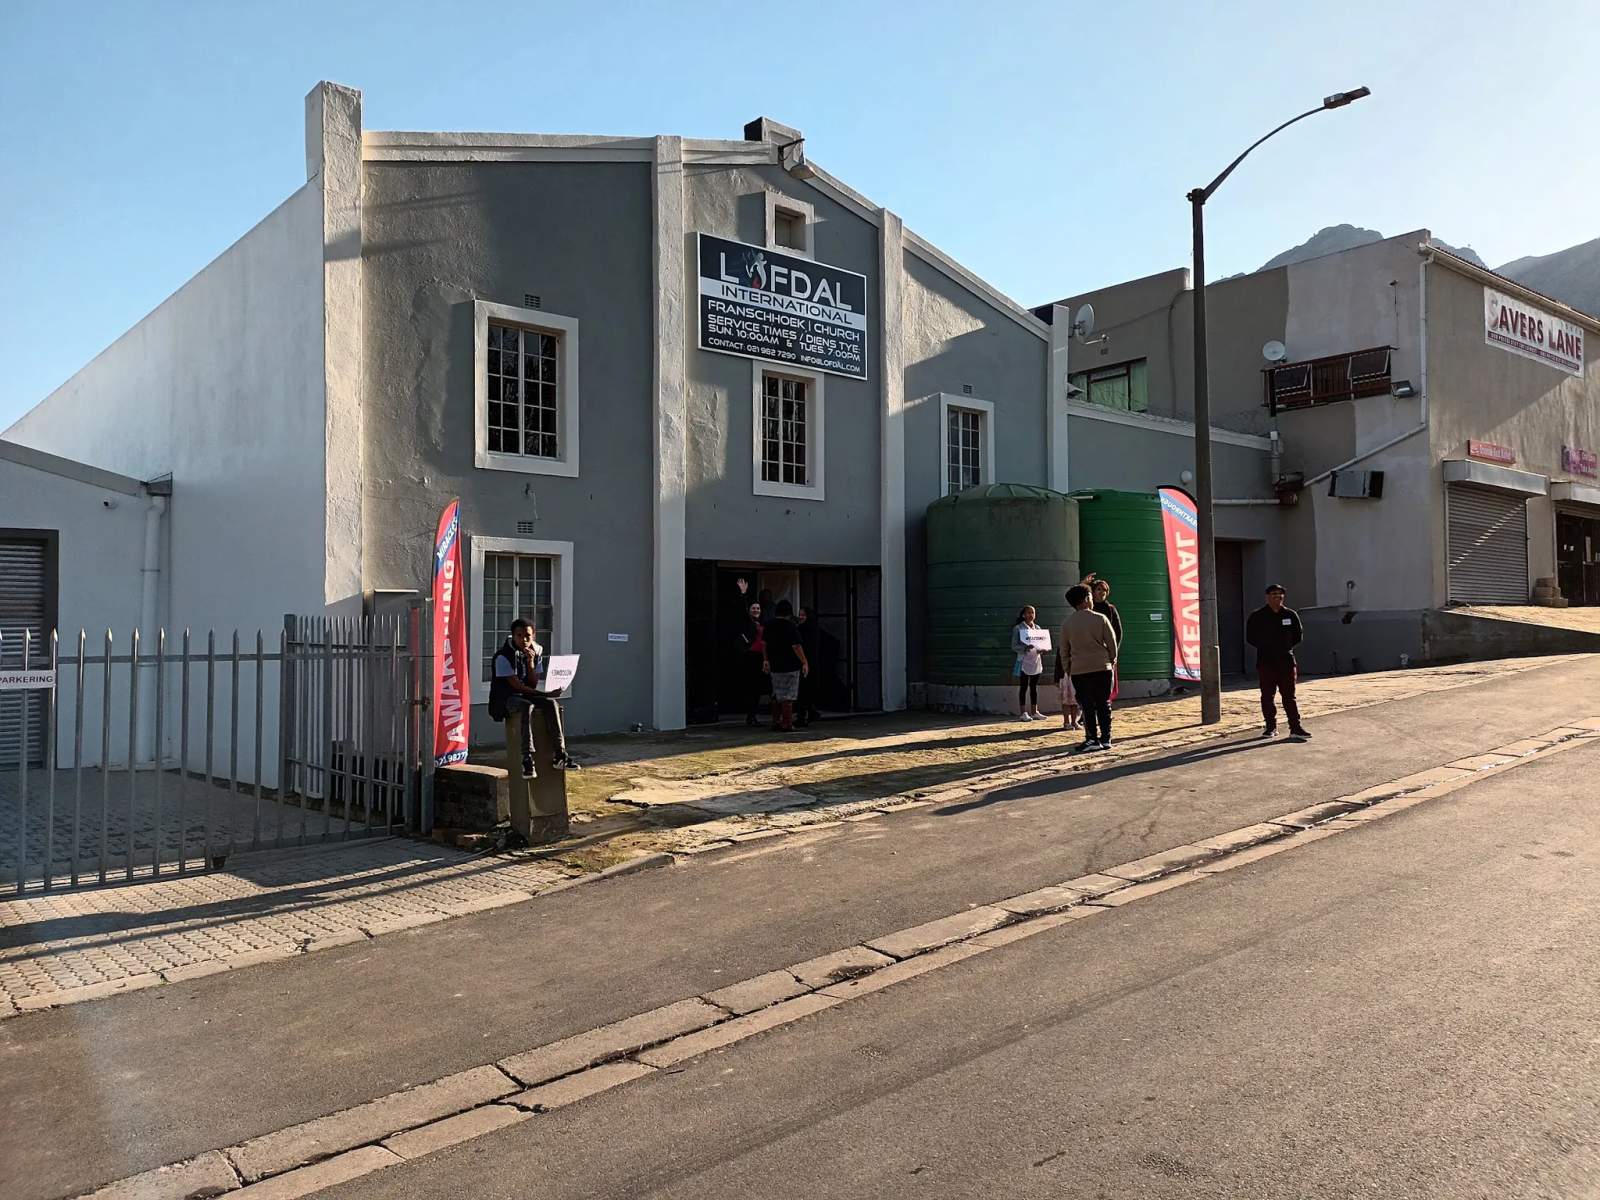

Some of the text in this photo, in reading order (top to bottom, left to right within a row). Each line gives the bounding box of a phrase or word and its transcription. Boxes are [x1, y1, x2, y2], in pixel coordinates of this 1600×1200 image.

[708, 300, 806, 330] FRANSCHHOEK
[814, 323, 860, 342] CHURCH
[721, 284, 853, 325] INTERNATIONAL
[708, 314, 760, 333] SERVICE
[762, 325, 797, 340] TIMES
[806, 334, 837, 349] DIENS
[708, 324, 860, 362] SUN. 10:00AM & TUES. 7:00PM
[708, 337, 746, 351] CONTACT:
[746, 344, 760, 353] 021
[1549, 325, 1582, 360] LANE
